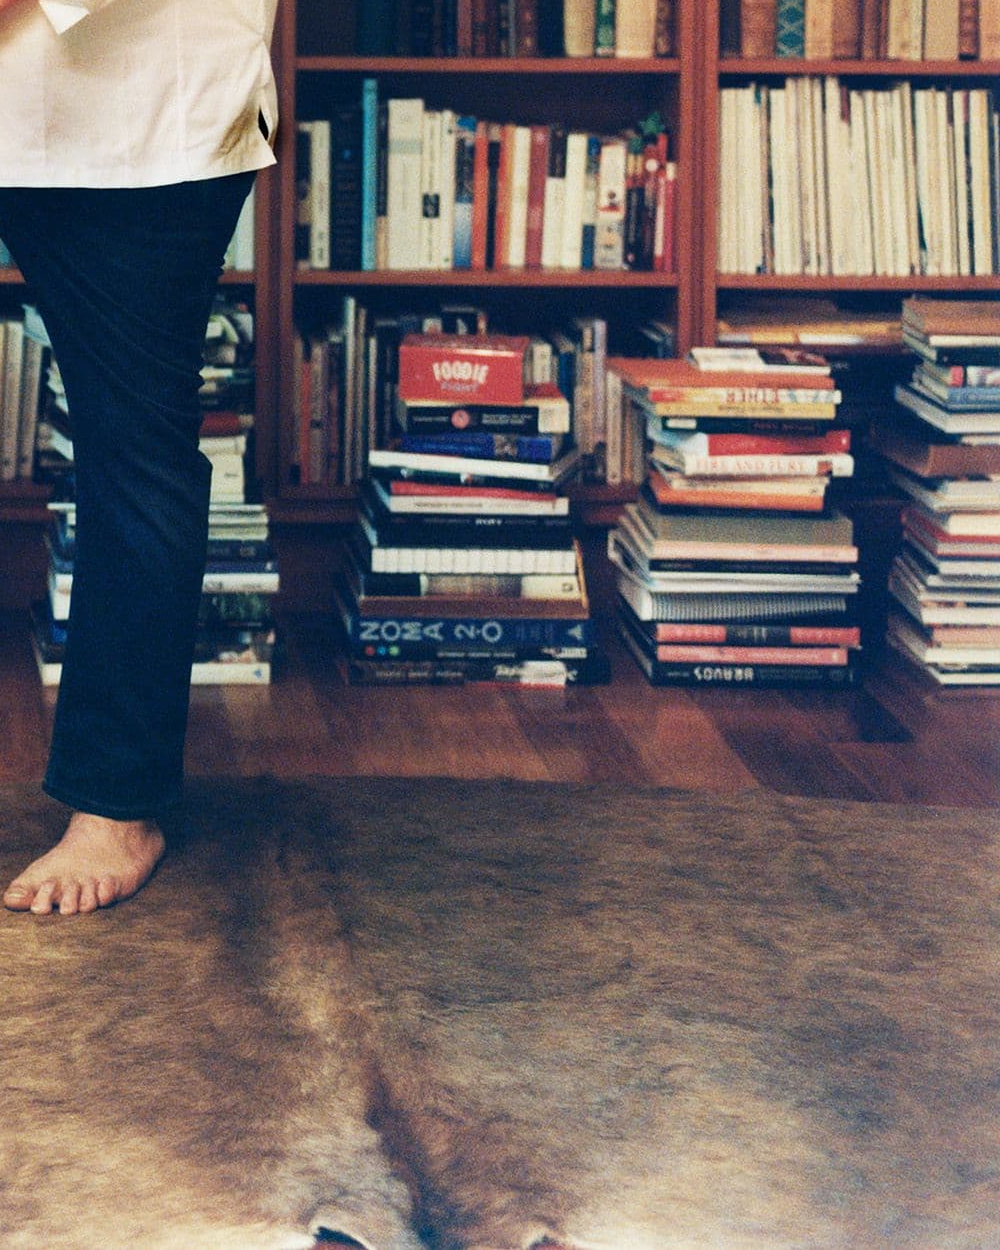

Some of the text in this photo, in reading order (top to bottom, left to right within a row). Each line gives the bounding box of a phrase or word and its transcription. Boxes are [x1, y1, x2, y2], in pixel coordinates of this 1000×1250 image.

[432, 360, 489, 384] FOODIE
[733, 457, 767, 473] AND
[769, 457, 807, 472] FURY
[359, 621, 446, 642] NOMA
[693, 666, 755, 681] BRAVOS
